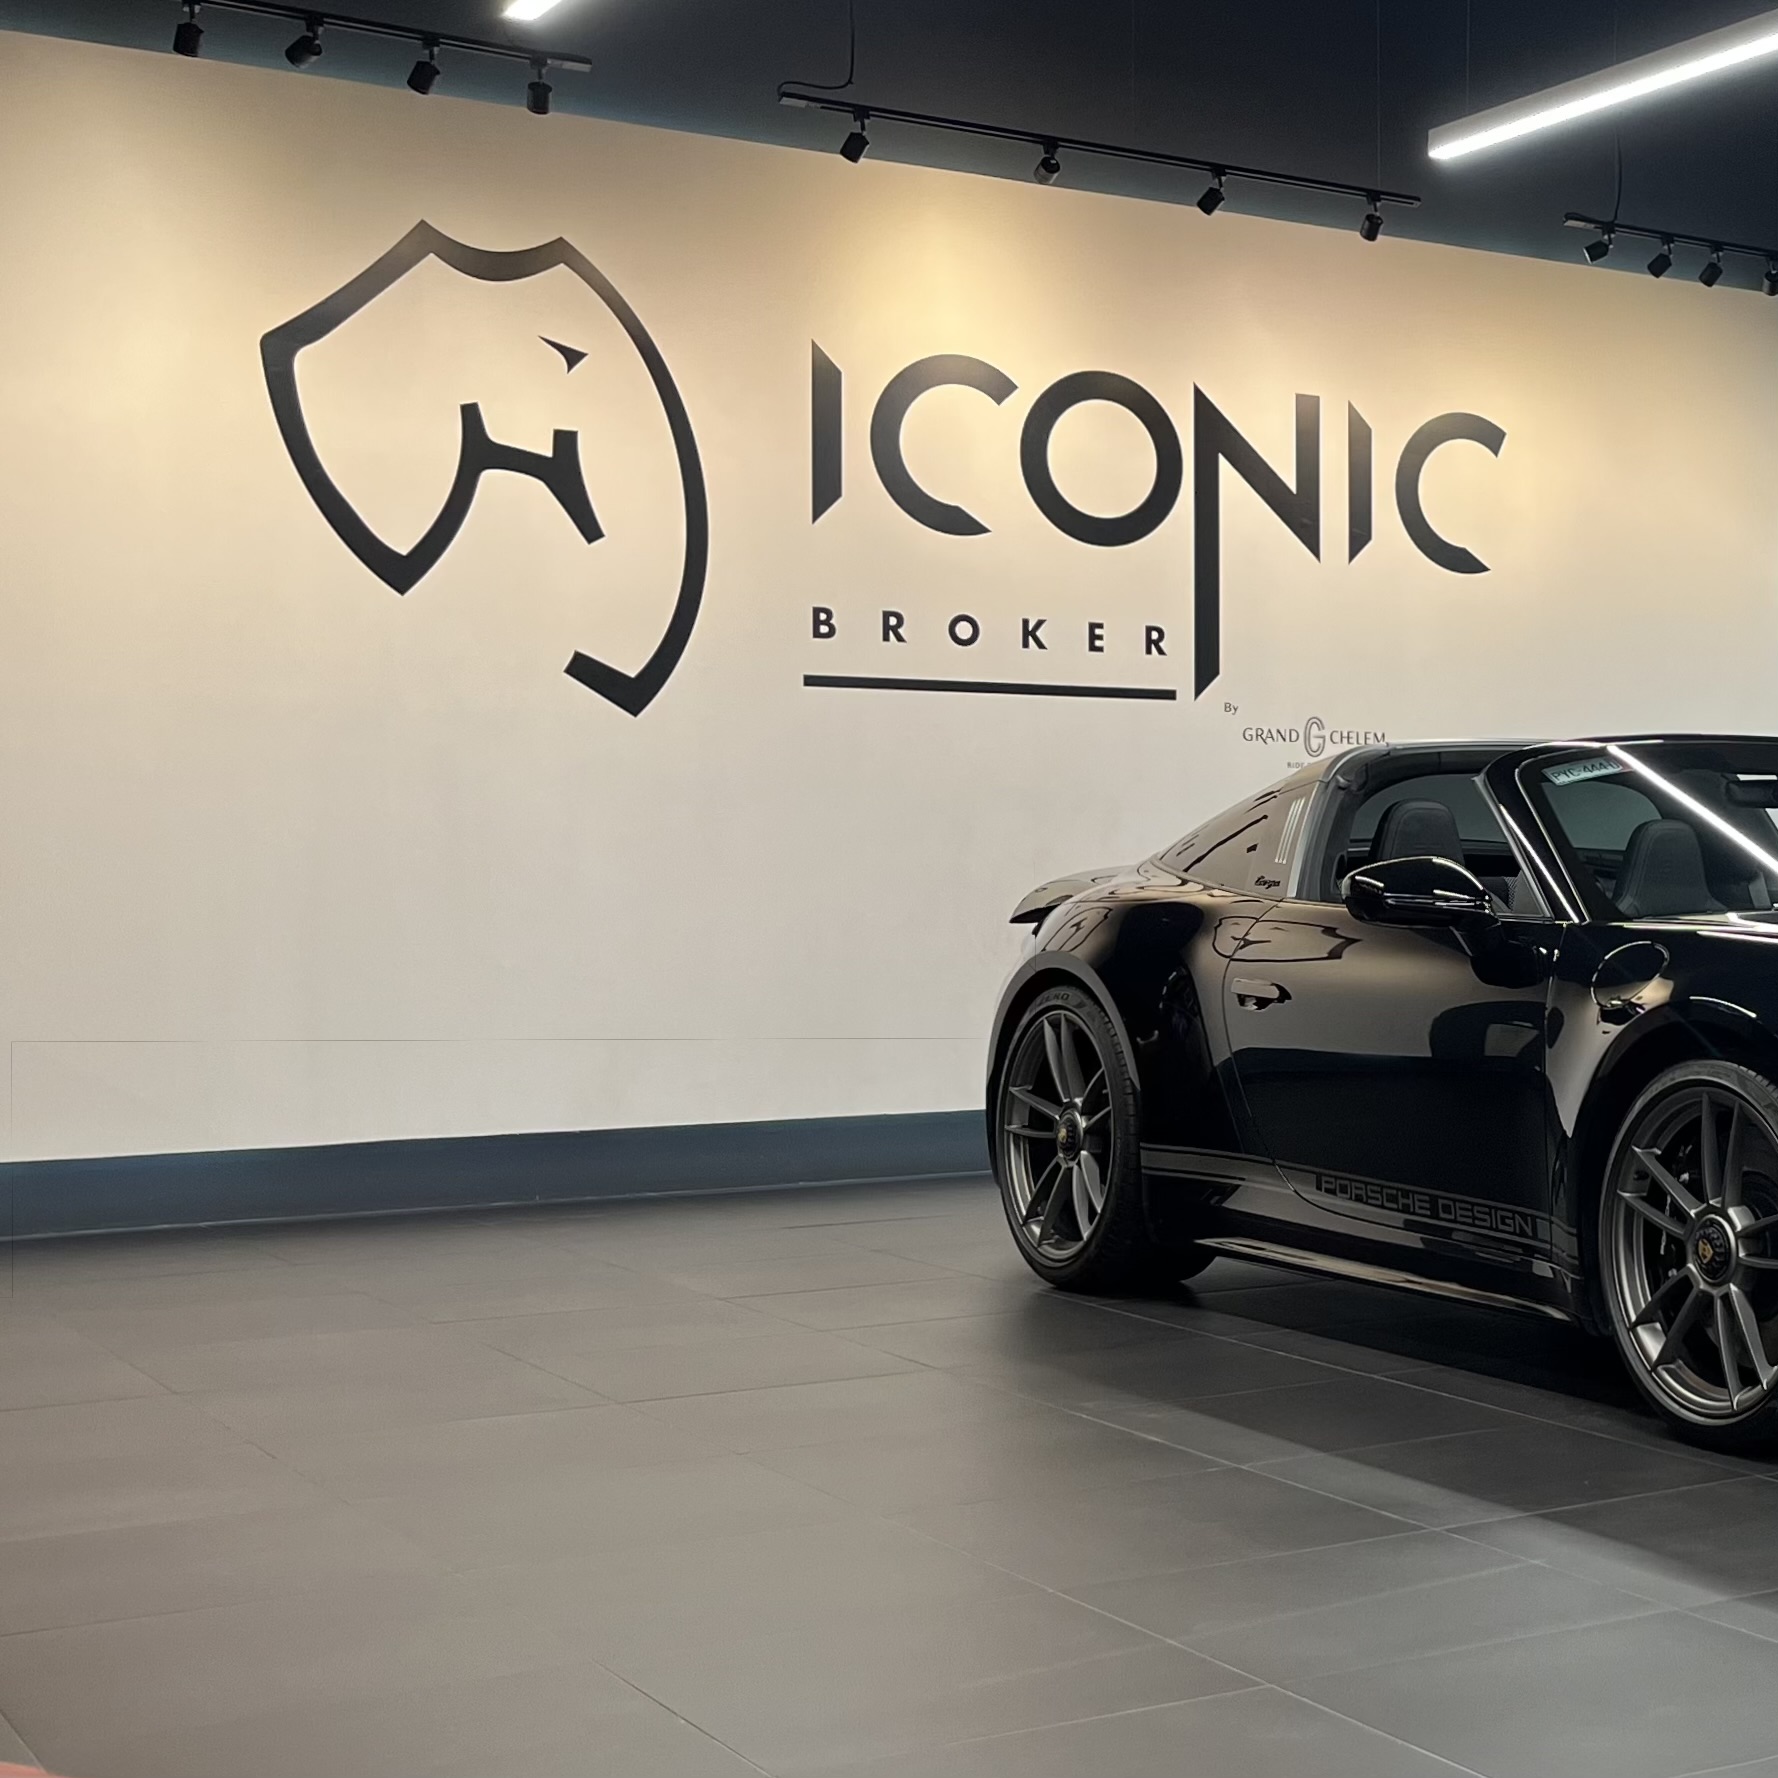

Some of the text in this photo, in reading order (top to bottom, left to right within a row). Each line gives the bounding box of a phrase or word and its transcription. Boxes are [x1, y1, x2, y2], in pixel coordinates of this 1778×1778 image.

[811, 338, 1507, 702] ICONIC
[811, 606, 1168, 657] BROKER
[1223, 702, 1239, 715] By
[1242, 727, 1300, 746] GRAND
[1329, 730, 1387, 746] CHELEM
[1320, 1175, 1533, 1237] PORSCHE DESIGN
